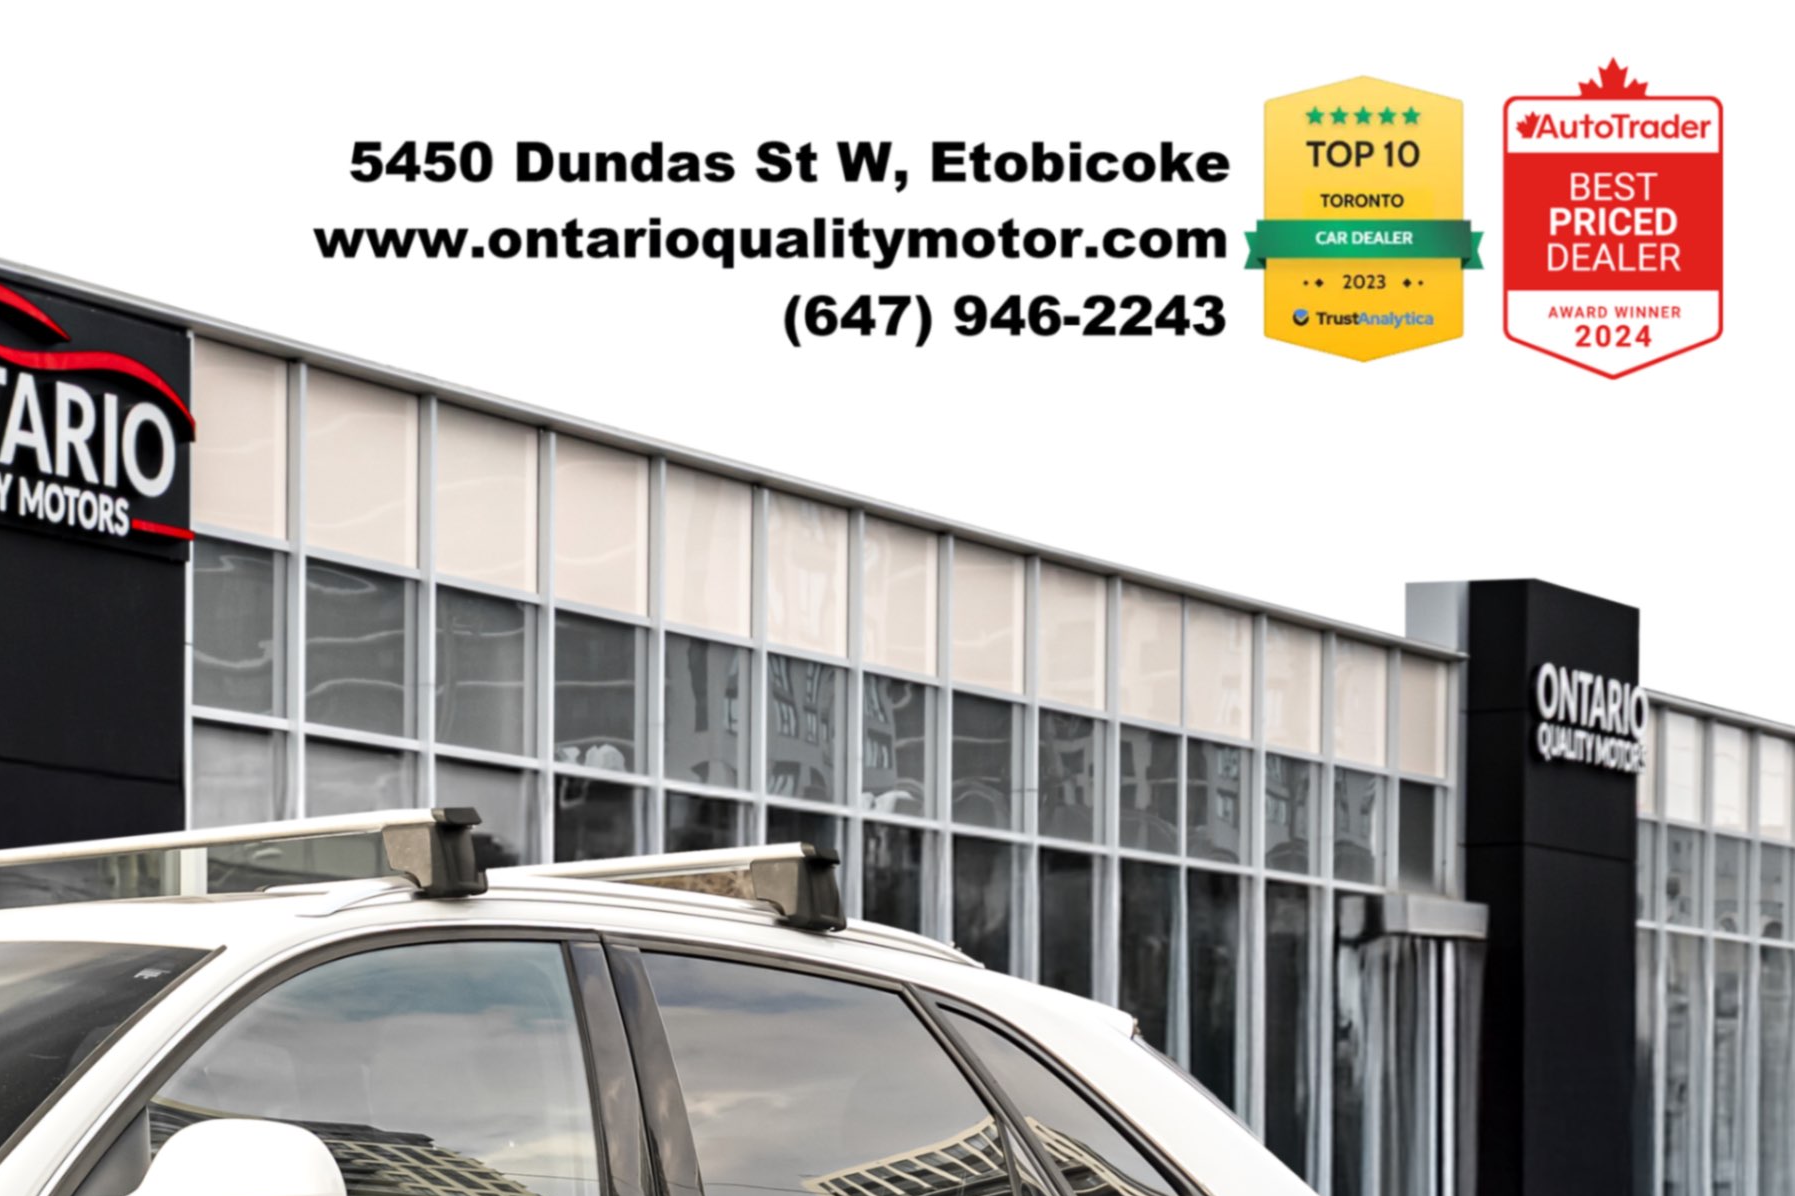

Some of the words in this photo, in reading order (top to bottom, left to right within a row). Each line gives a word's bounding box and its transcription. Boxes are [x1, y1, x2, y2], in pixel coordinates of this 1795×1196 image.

[18, 476, 131, 537] MOTORS
[1537, 662, 1648, 741] ONTARIO
[1537, 721, 1596, 762] QUALITY
